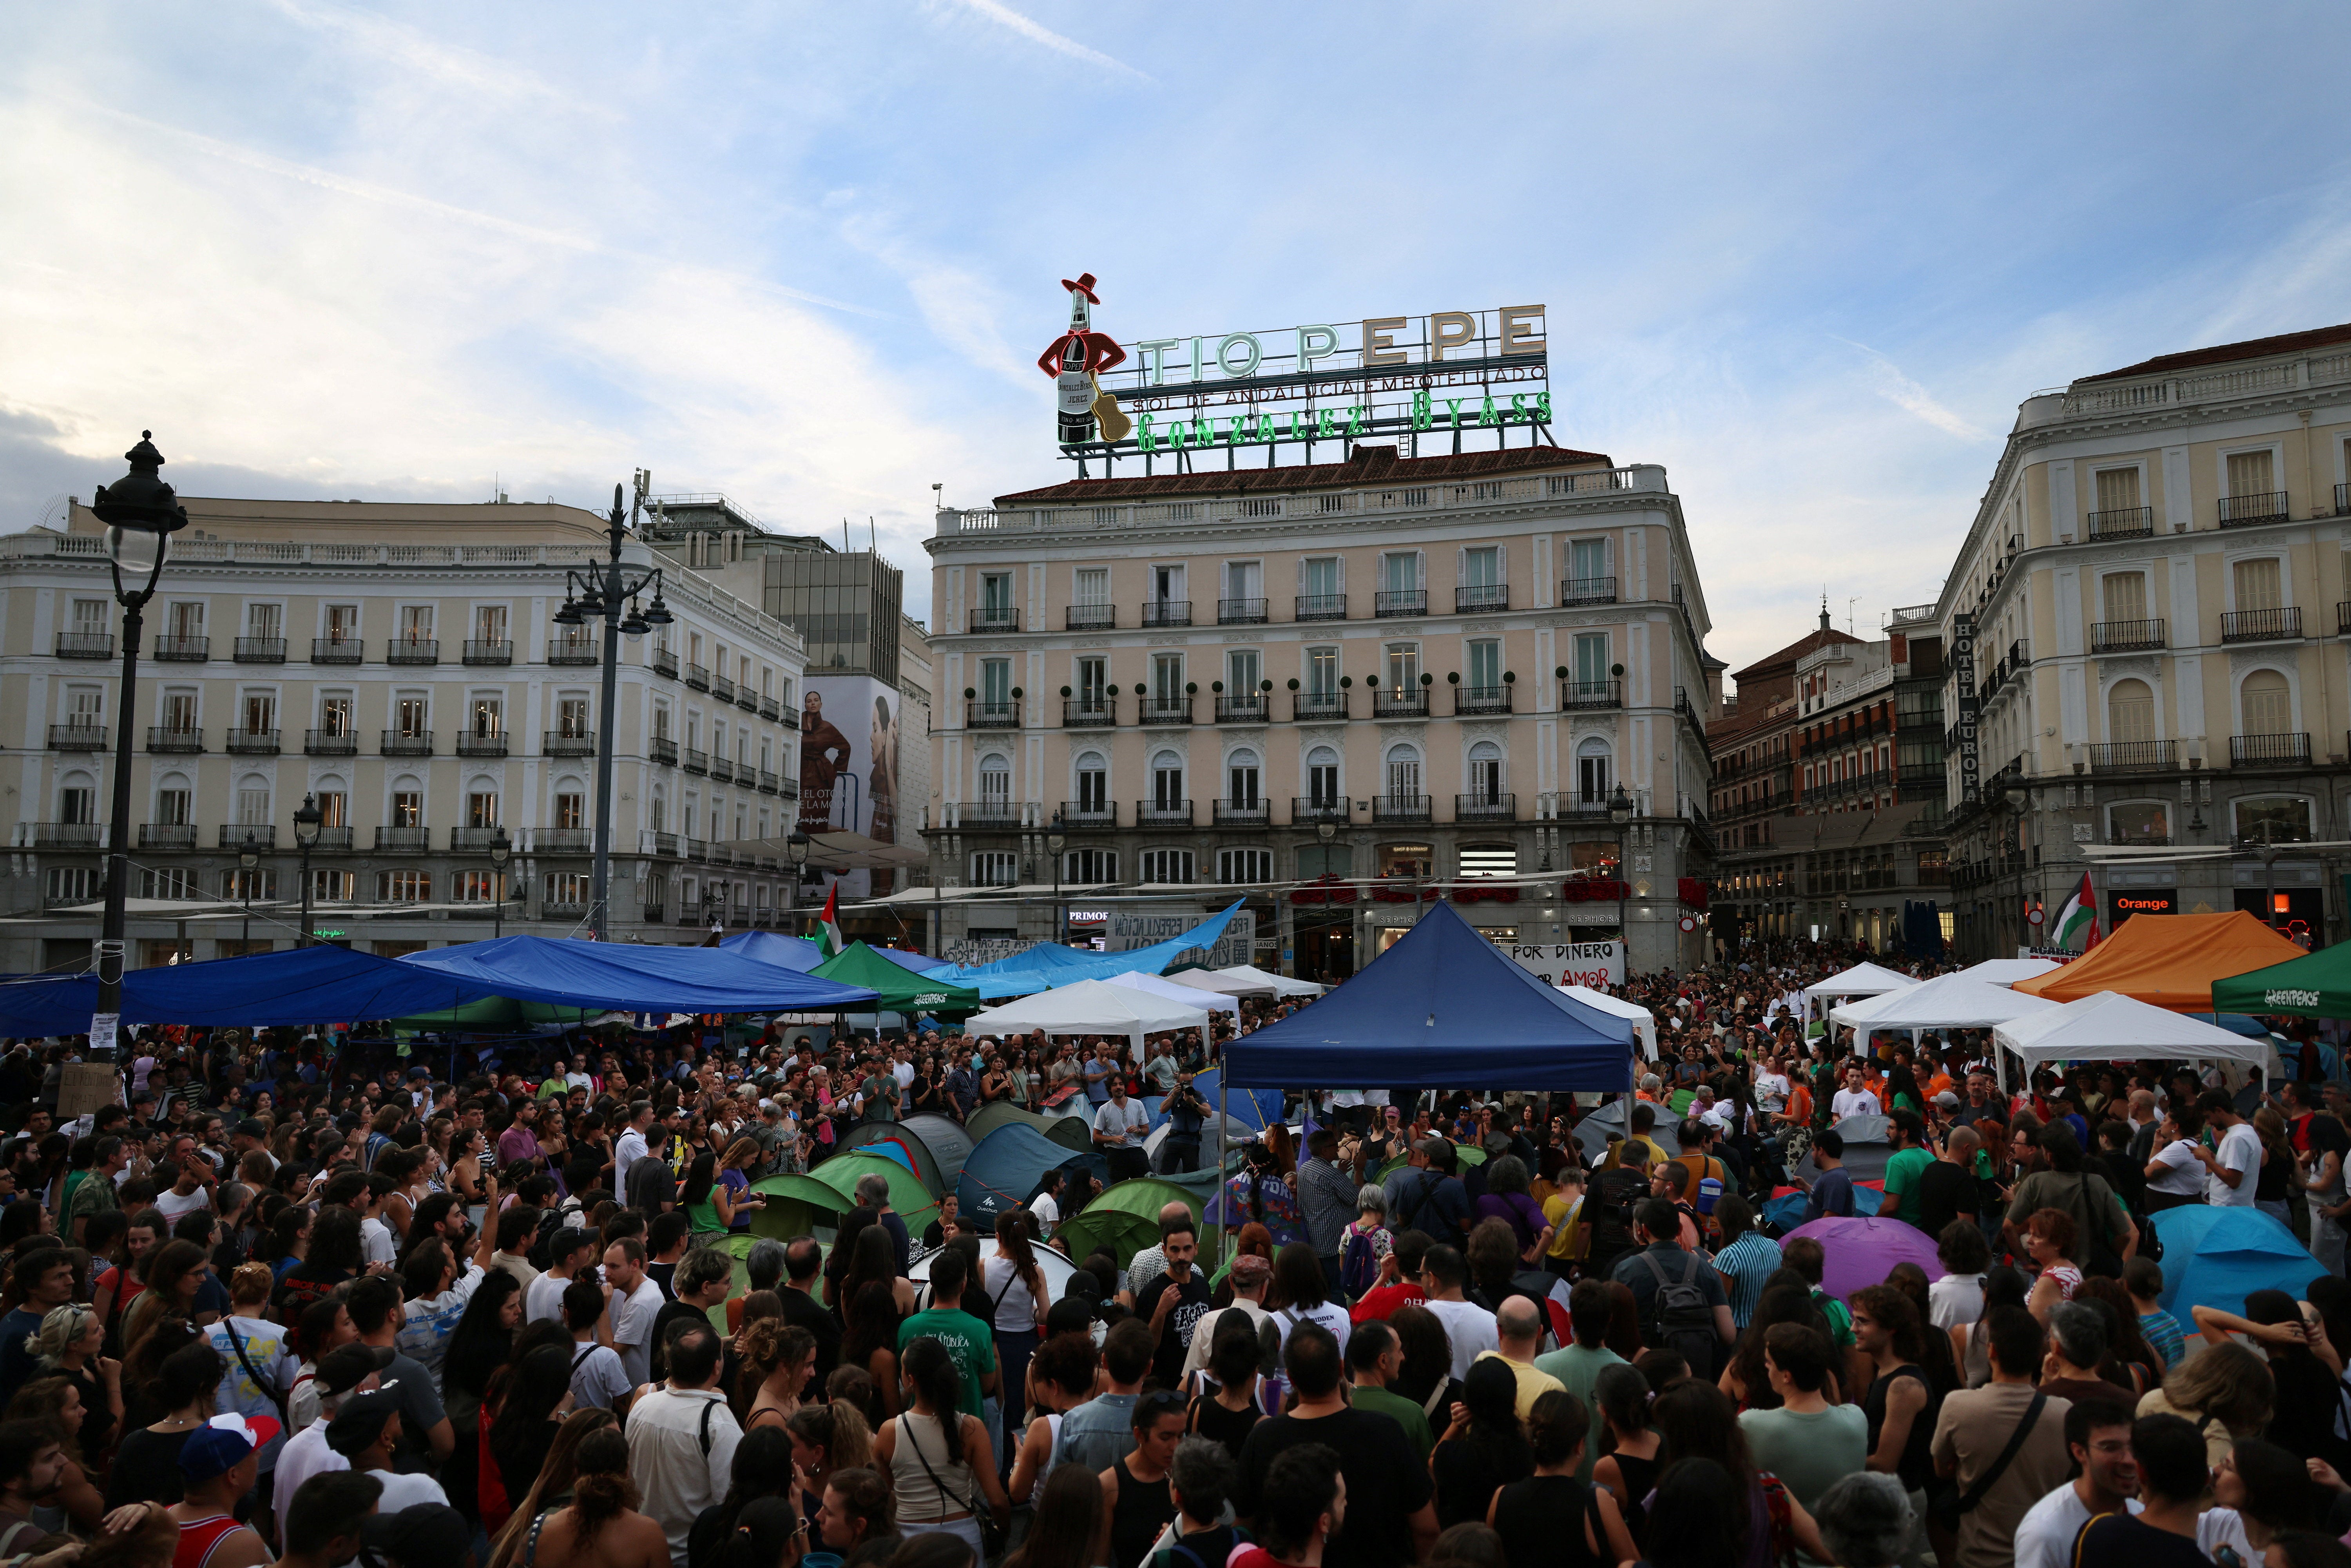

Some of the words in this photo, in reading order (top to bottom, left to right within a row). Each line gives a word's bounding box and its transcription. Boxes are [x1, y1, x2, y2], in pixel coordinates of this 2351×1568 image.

[1137, 332, 1262, 386] TIO
[1297, 304, 1546, 373] PEPE
[1133, 397, 1178, 412] SOL
[1187, 393, 1215, 407] DE
[1225, 380, 1354, 405] ANDALUCIA
[1366, 366, 1545, 392] EMBOTELLADO
[1068, 395, 1088, 404] JEREZ
[1137, 405, 1364, 451] GONZALEZ
[1412, 391, 1552, 431] BYASS
[1956, 624, 1973, 699] HOTEL
[1961, 710, 1978, 802] EUROPA
[804, 790, 815, 798] EL
[807, 800, 818, 809] LA
[821, 800, 850, 809] MODA
[2117, 898, 2168, 911] Orange
[322, 927, 345, 938] Inglés
[1512, 945, 1544, 960] POR
[1556, 943, 1613, 961] DINERO
[1537, 974, 1553, 987] OR
[1561, 968, 1610, 988] AMOR
[914, 994, 947, 1006] GREENPEACE
[2265, 989, 2320, 1007] GREENPEACE
[284, 1278, 315, 1291] EUROPE
